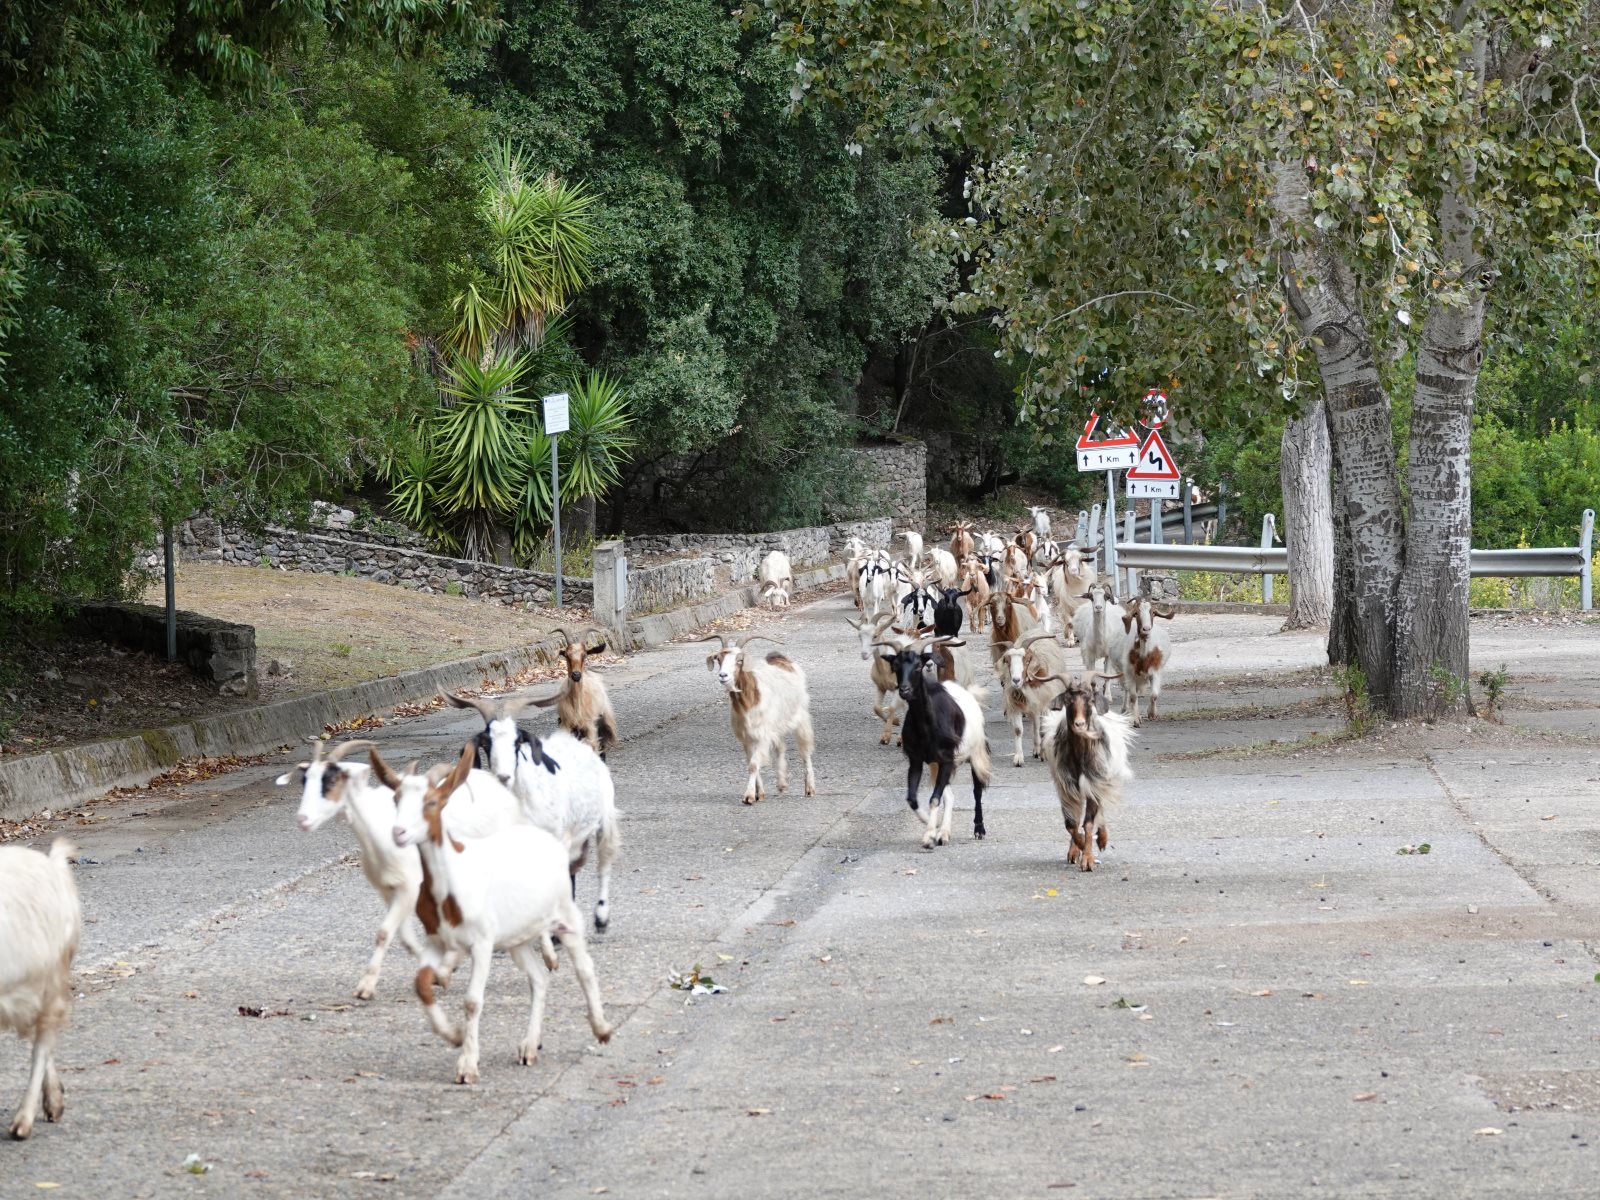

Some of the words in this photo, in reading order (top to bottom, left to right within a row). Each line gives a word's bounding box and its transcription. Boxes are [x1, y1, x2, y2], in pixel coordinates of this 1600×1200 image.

[1099, 455, 1103, 464] 1
[1106, 455, 1120, 463] Km
[1144, 485, 1148, 493] 1
